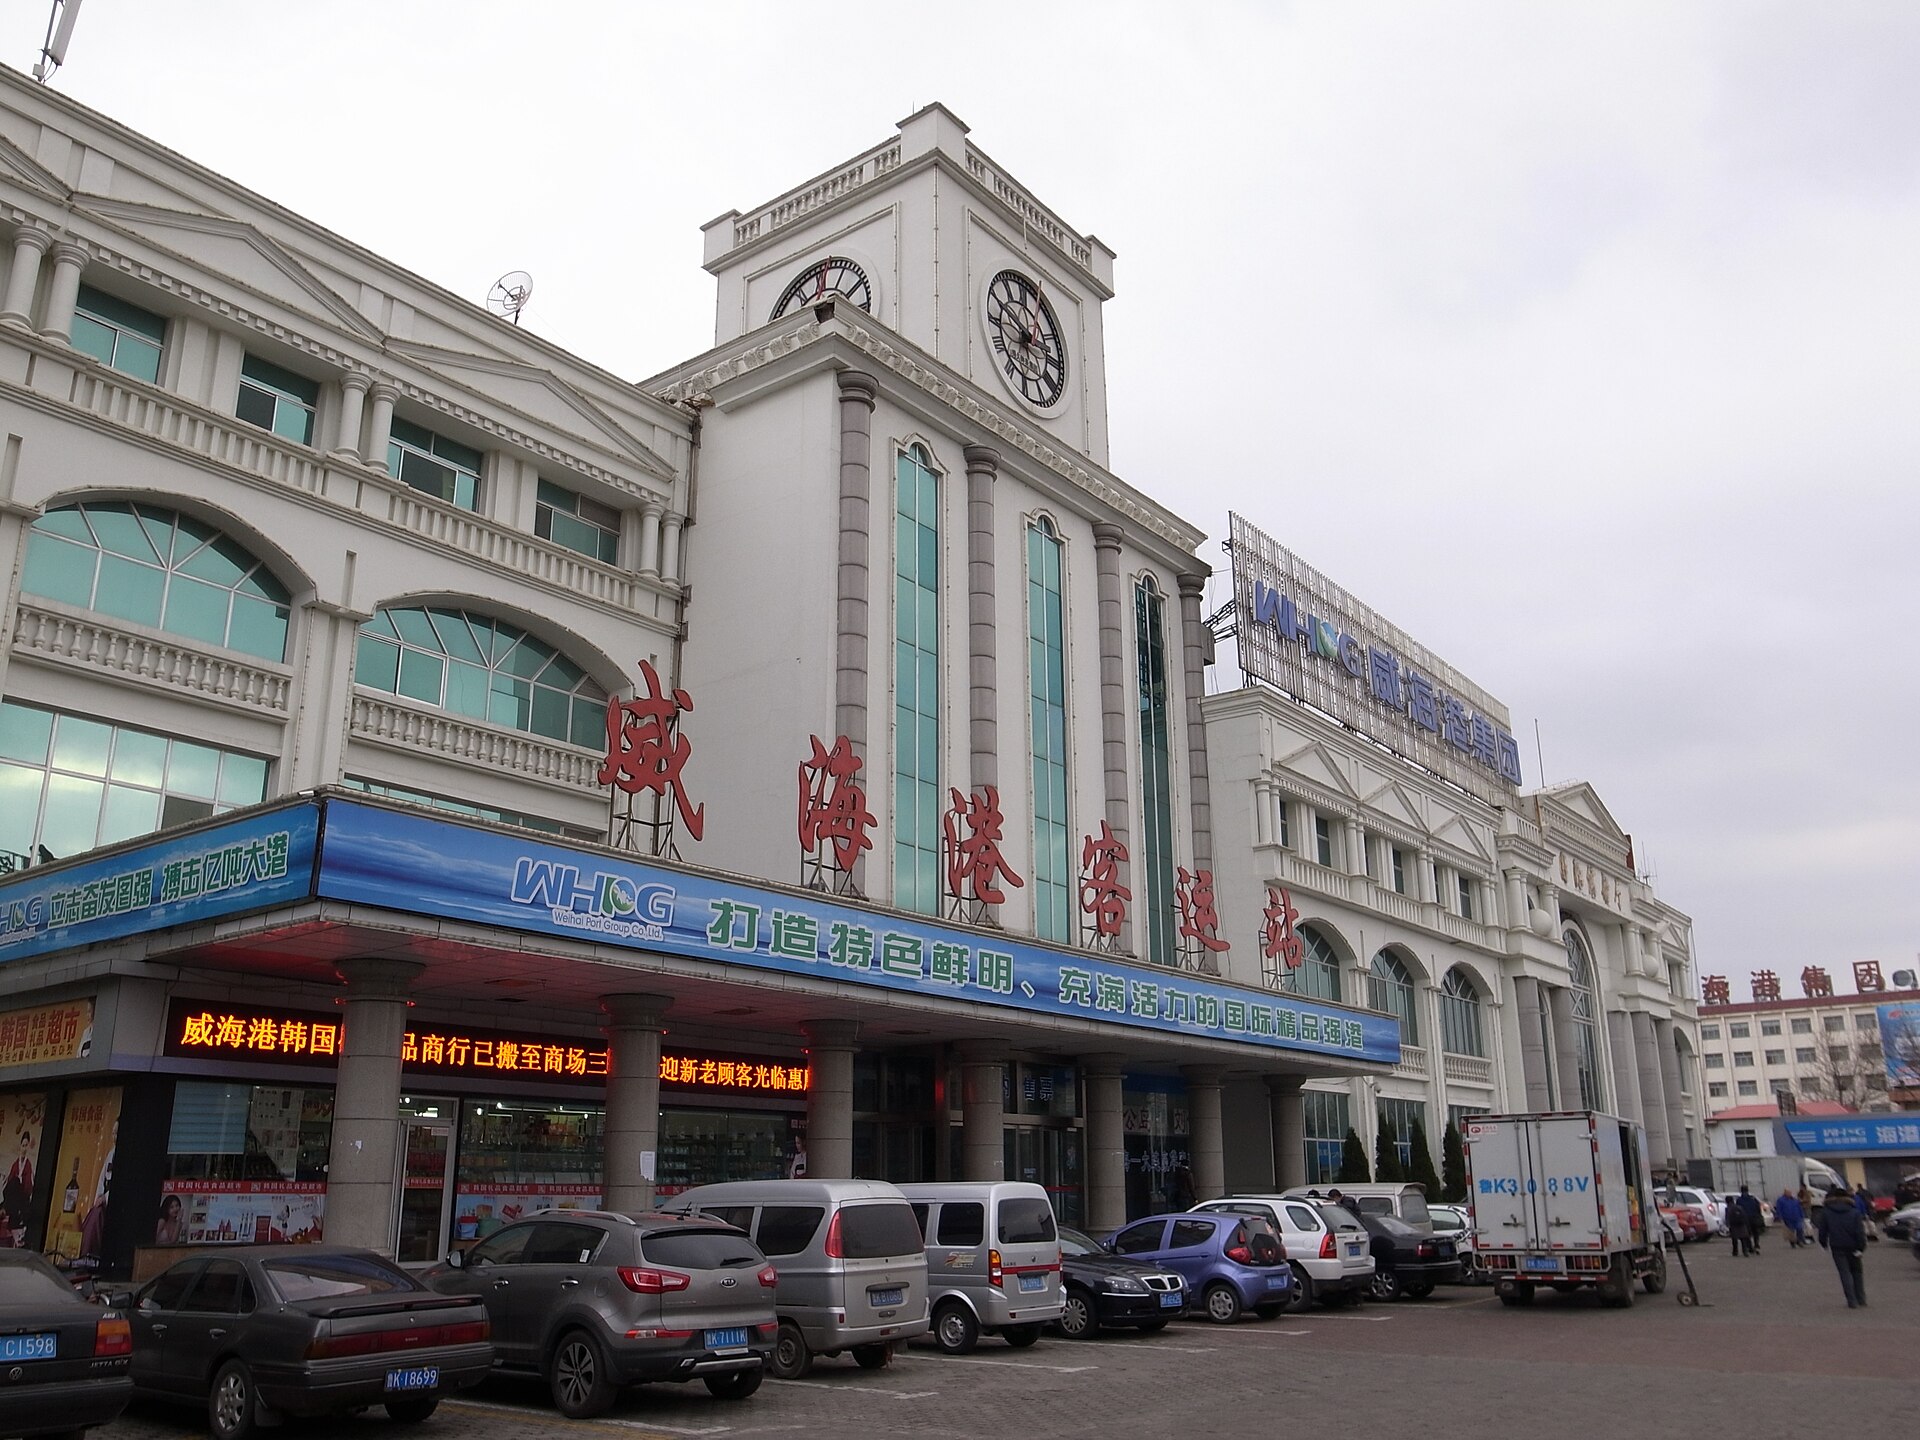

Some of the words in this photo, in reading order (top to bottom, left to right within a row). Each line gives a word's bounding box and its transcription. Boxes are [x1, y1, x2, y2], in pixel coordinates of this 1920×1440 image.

[1368, 643, 1522, 788] 威海港集团
[48, 867, 153, 930] 立志奋发图强
[161, 831, 290, 905] 搏击亿吨大港
[554, 910, 584, 926] Weihai
[586, 917, 602, 929] Port
[604, 920, 631, 935] Group
[708, 897, 1366, 1052] 打造特色鲜明、充满活力的国际精品强港
[1701, 960, 1884, 1004] 海港集团
[181, 1012, 346, 1057] 威海港韩国
[401, 1033, 612, 1076] 品商行已搬至商场三
